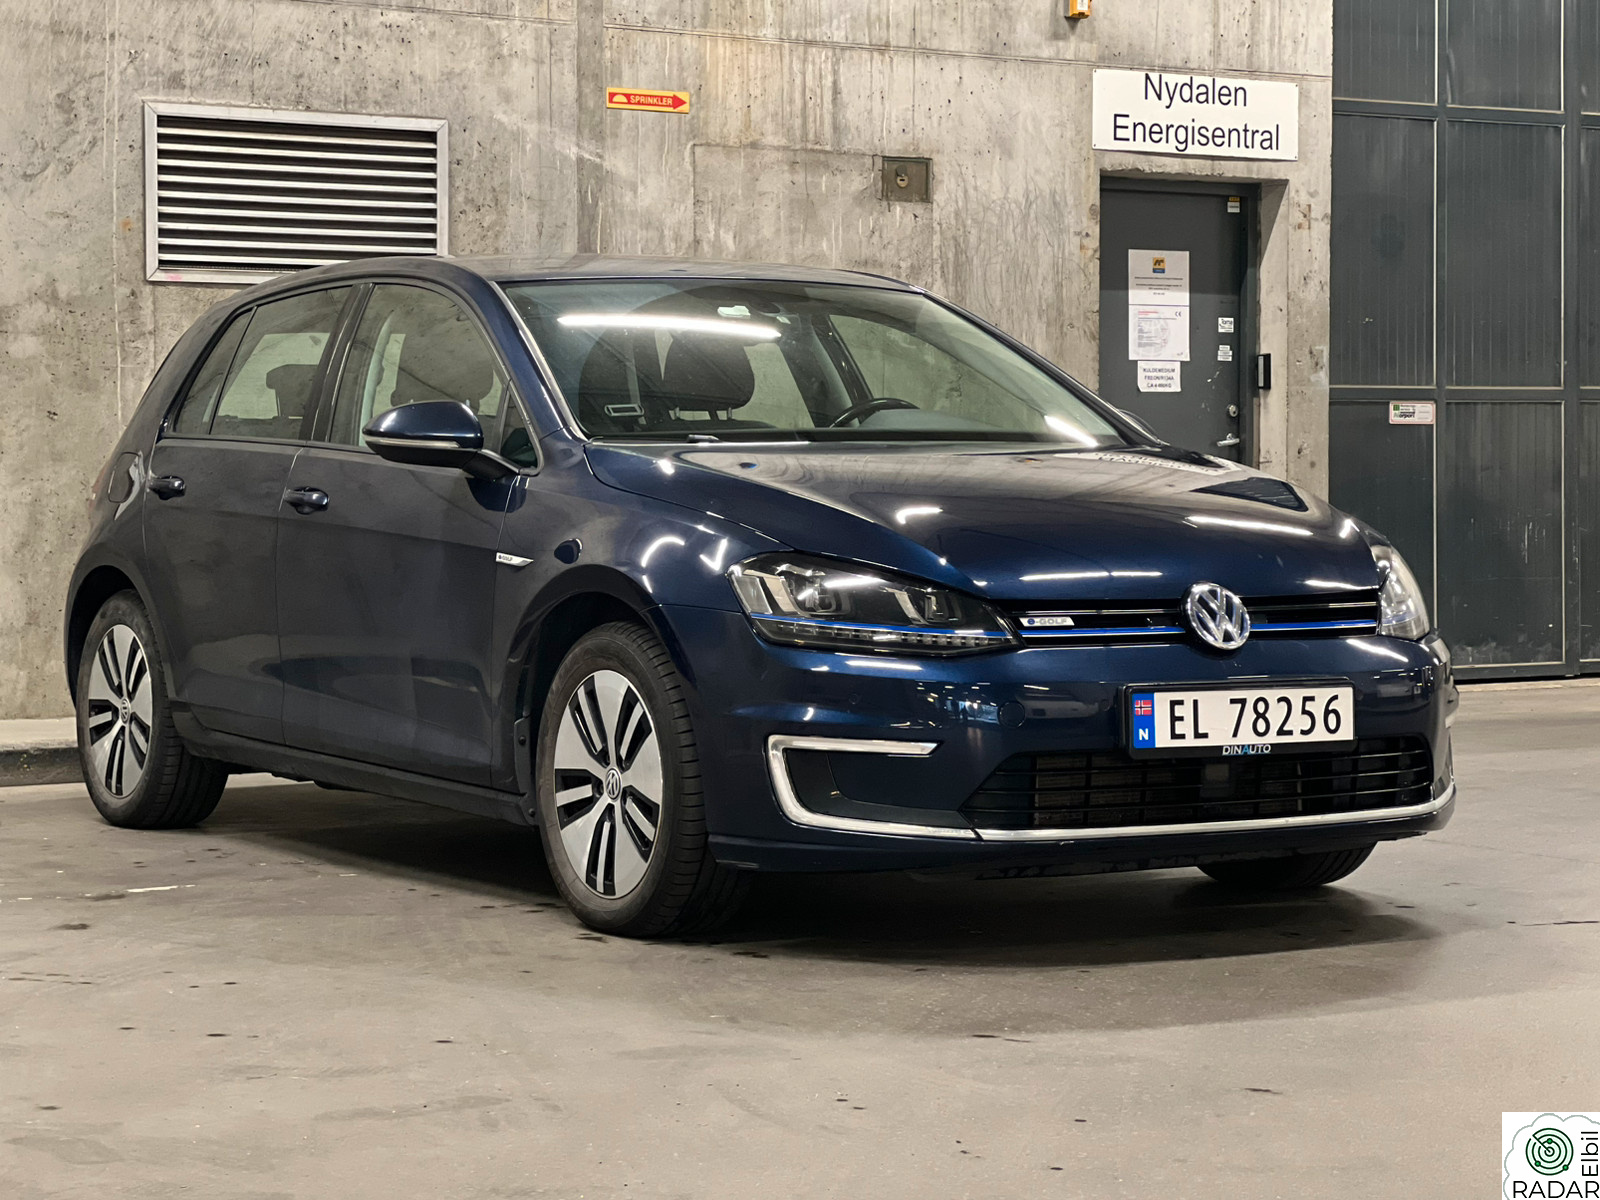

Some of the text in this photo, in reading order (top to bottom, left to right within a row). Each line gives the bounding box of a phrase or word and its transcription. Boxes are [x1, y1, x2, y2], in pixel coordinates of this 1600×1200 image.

[630, 95, 673, 106] SPRINKLER
[1144, 72, 1248, 109] Nydalen
[1113, 113, 1280, 152] Energisentral
[1169, 694, 1342, 740] EL 78256
[1138, 728, 1149, 740] N
[1222, 744, 1272, 755] DINAUTO
